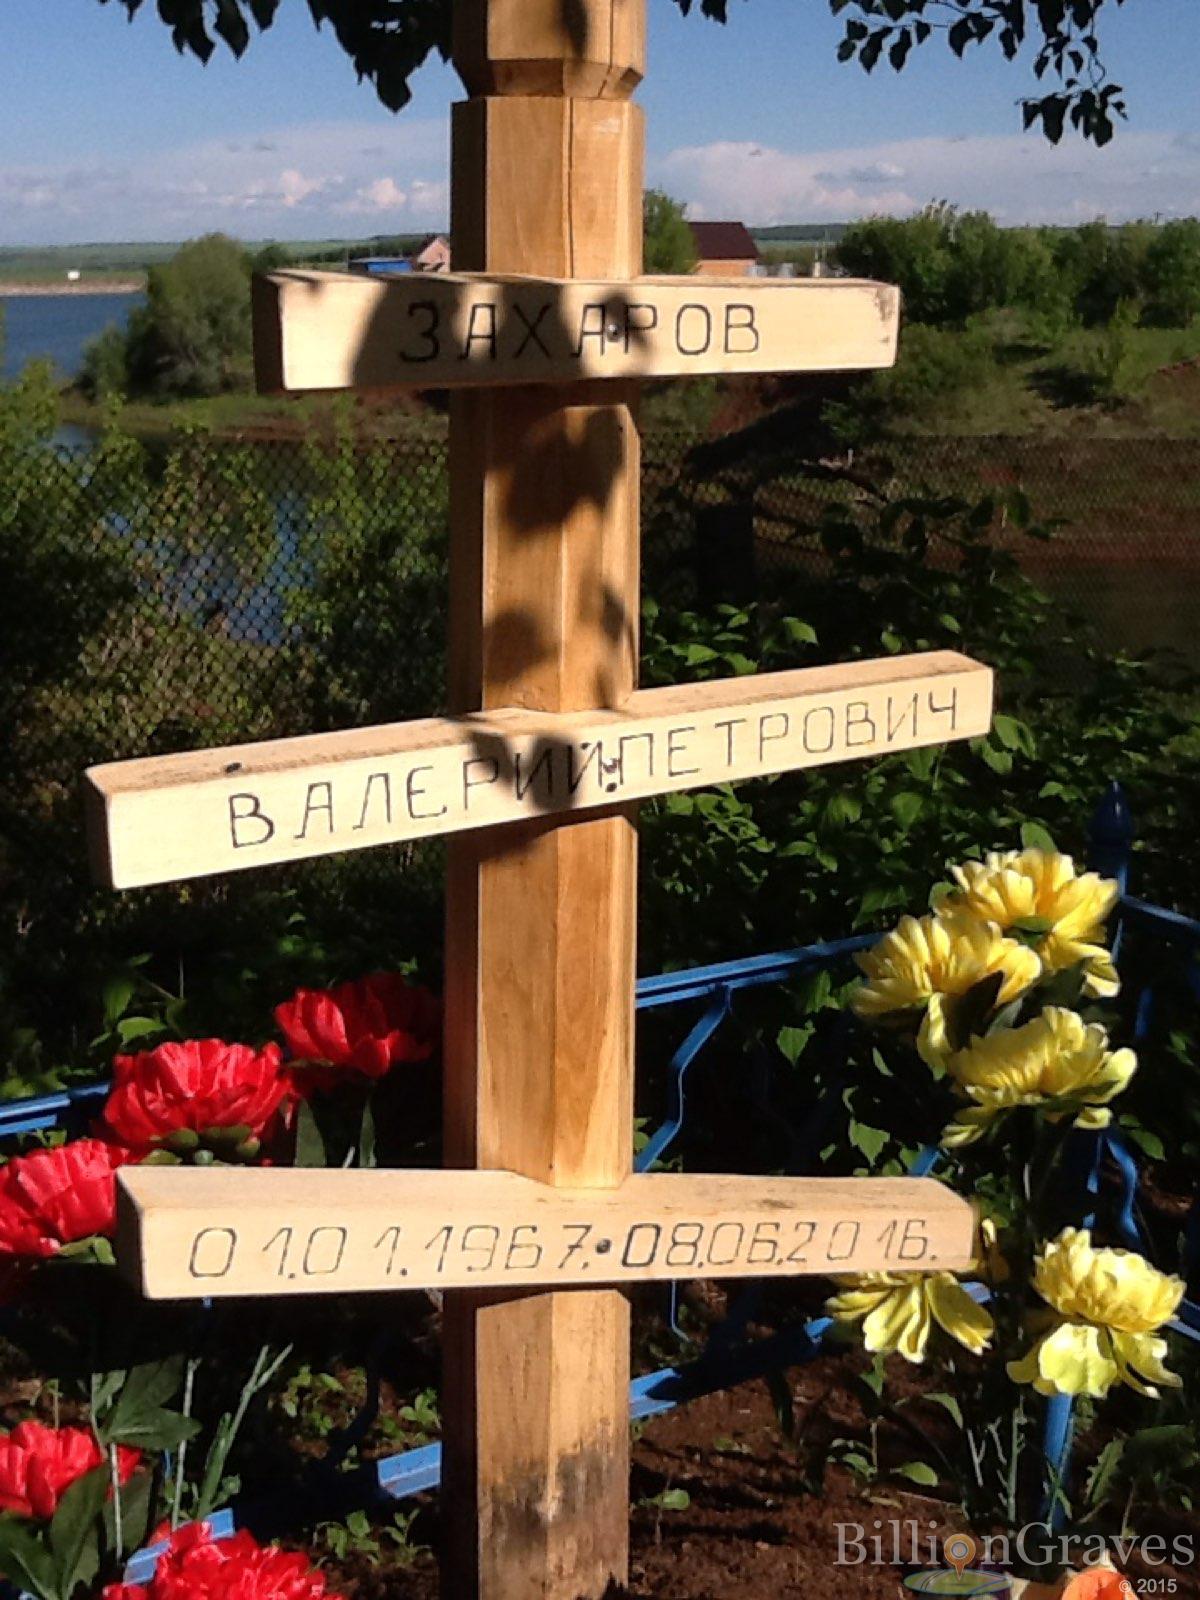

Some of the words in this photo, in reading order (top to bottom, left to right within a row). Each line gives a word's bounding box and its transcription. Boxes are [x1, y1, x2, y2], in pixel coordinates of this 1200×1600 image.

[399, 302, 760, 362] ЗАХАРОВ
[228, 740, 603, 849] ВАЛЕРИЙ
[618, 687, 957, 787] ПЕТРОВИЧ
